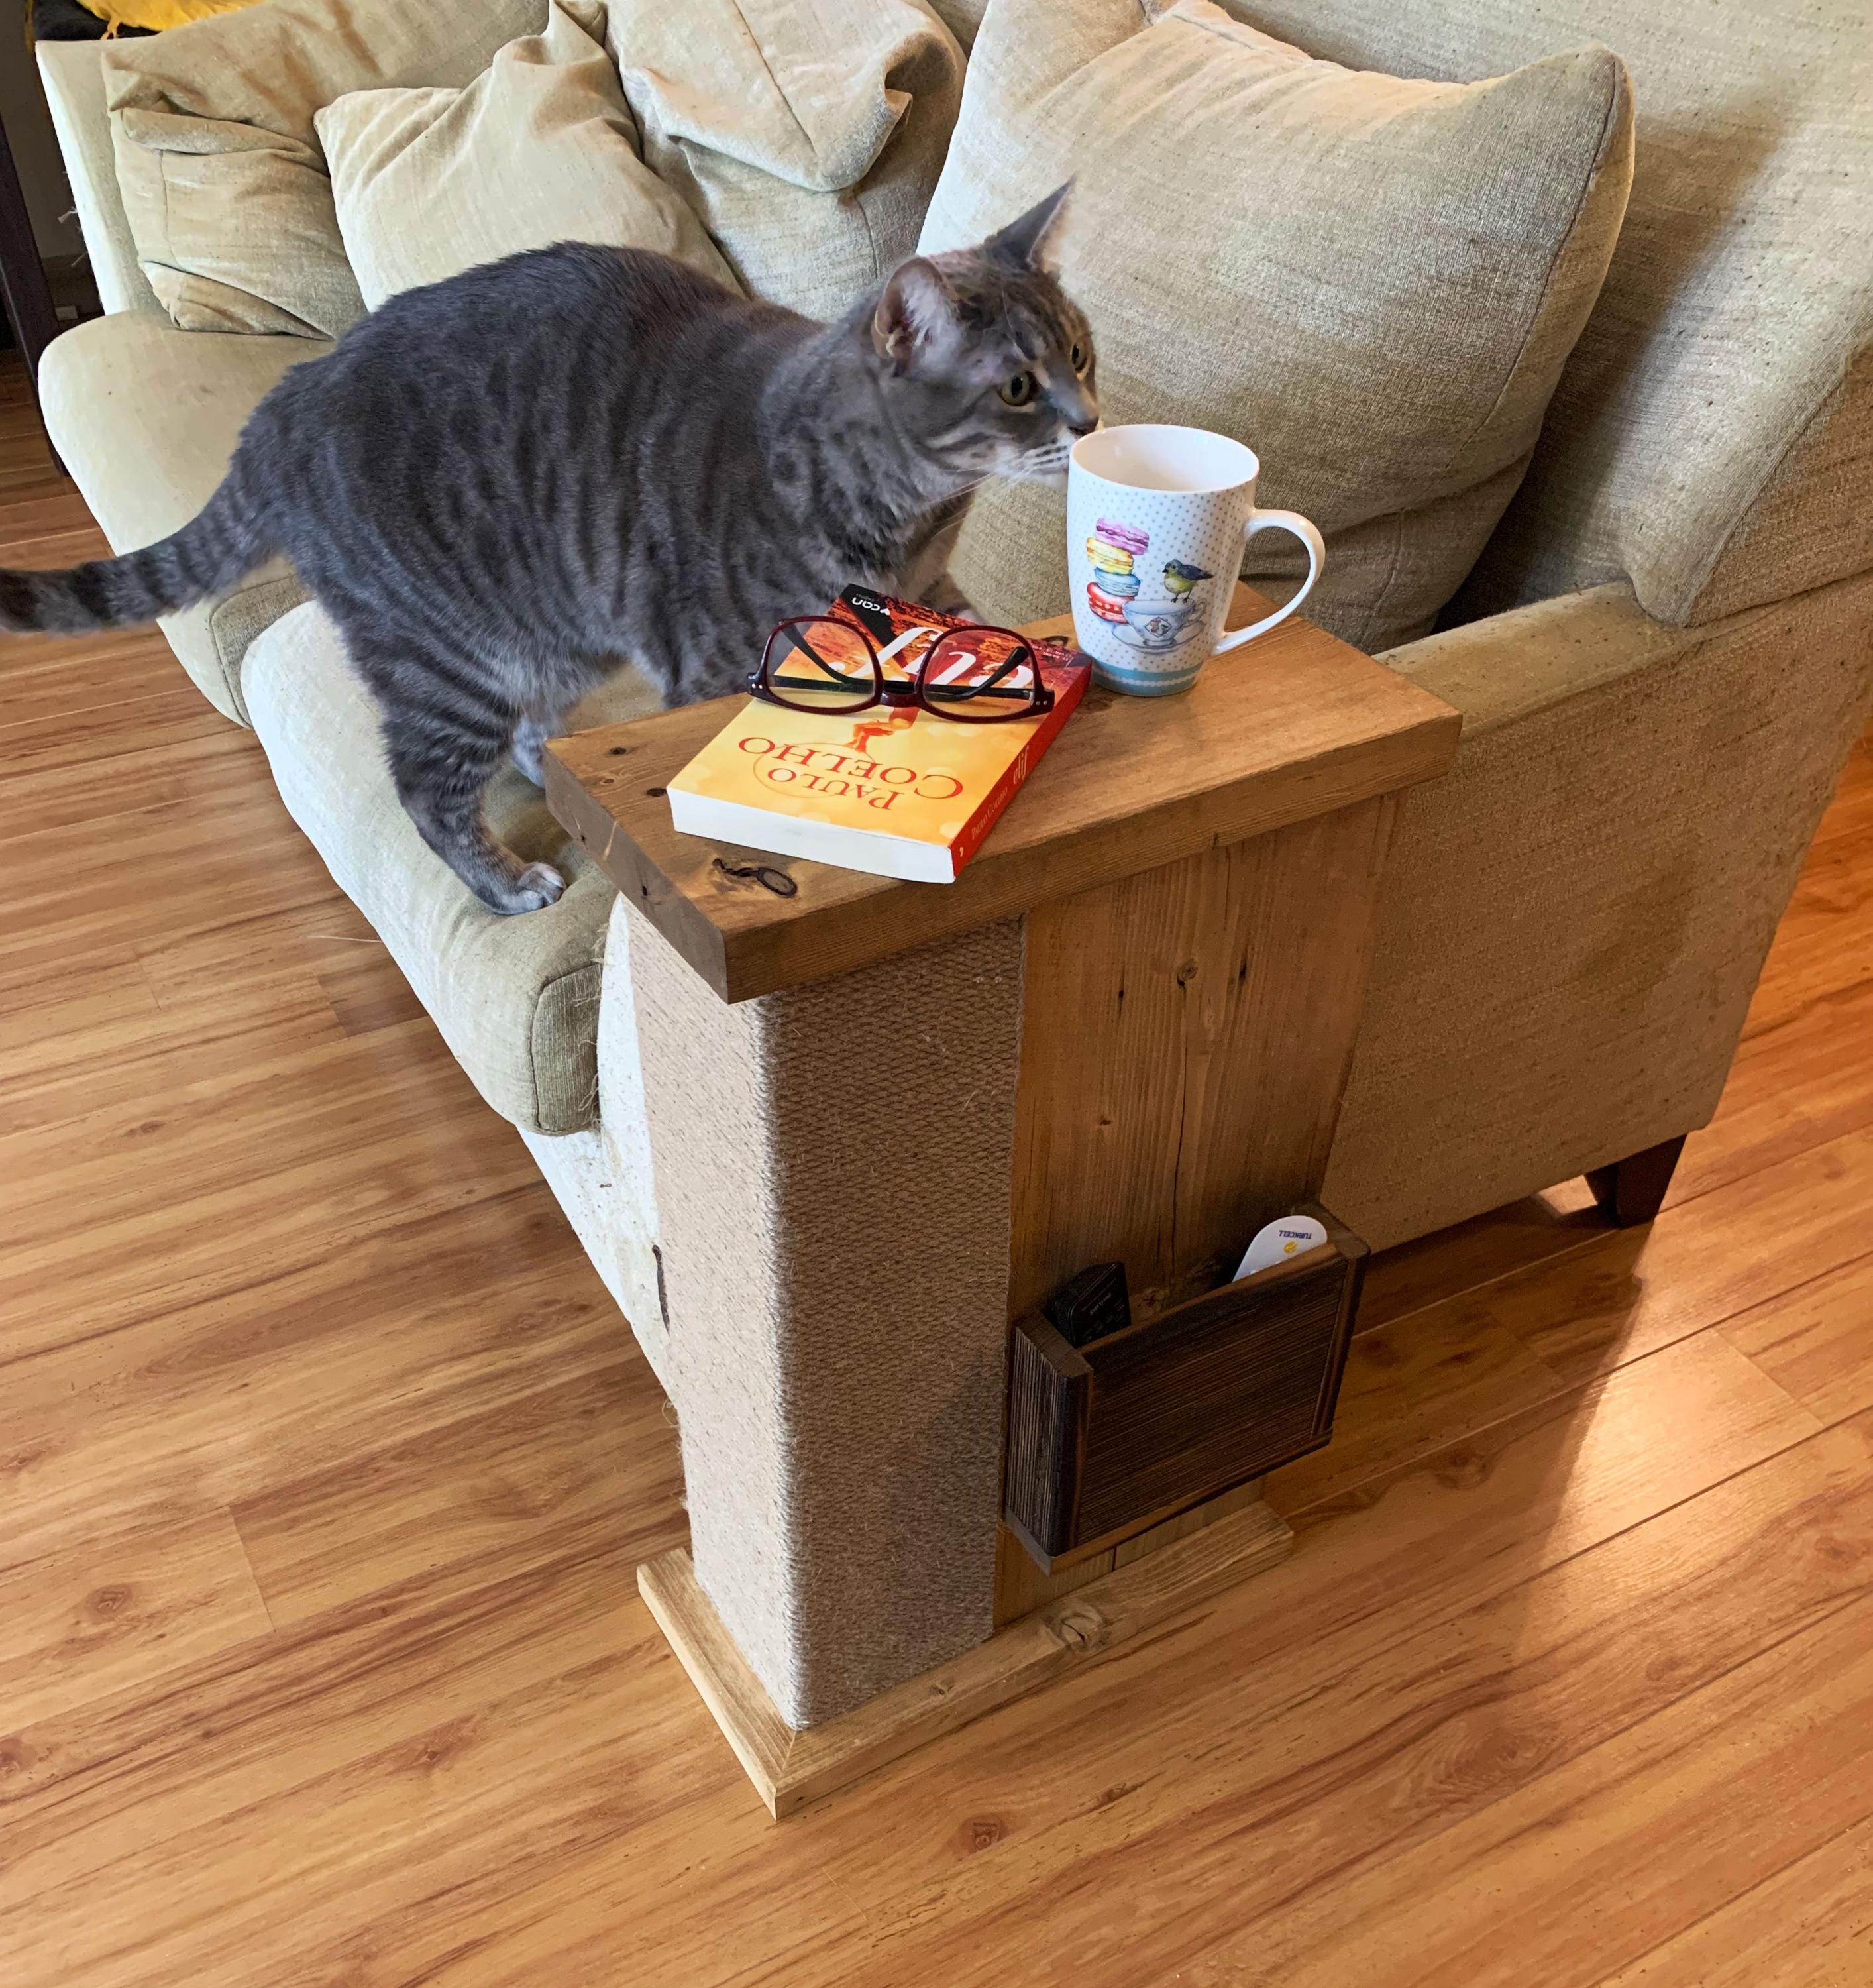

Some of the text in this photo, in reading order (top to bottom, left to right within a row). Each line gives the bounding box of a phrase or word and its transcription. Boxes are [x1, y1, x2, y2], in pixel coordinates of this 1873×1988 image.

[851, 597, 881, 611] can
[738, 736, 963, 799] COELHO
[1013, 744, 1030, 784] elif
[767, 767, 902, 810] PAULO
[1278, 1229, 1312, 1240] TURKCELL
